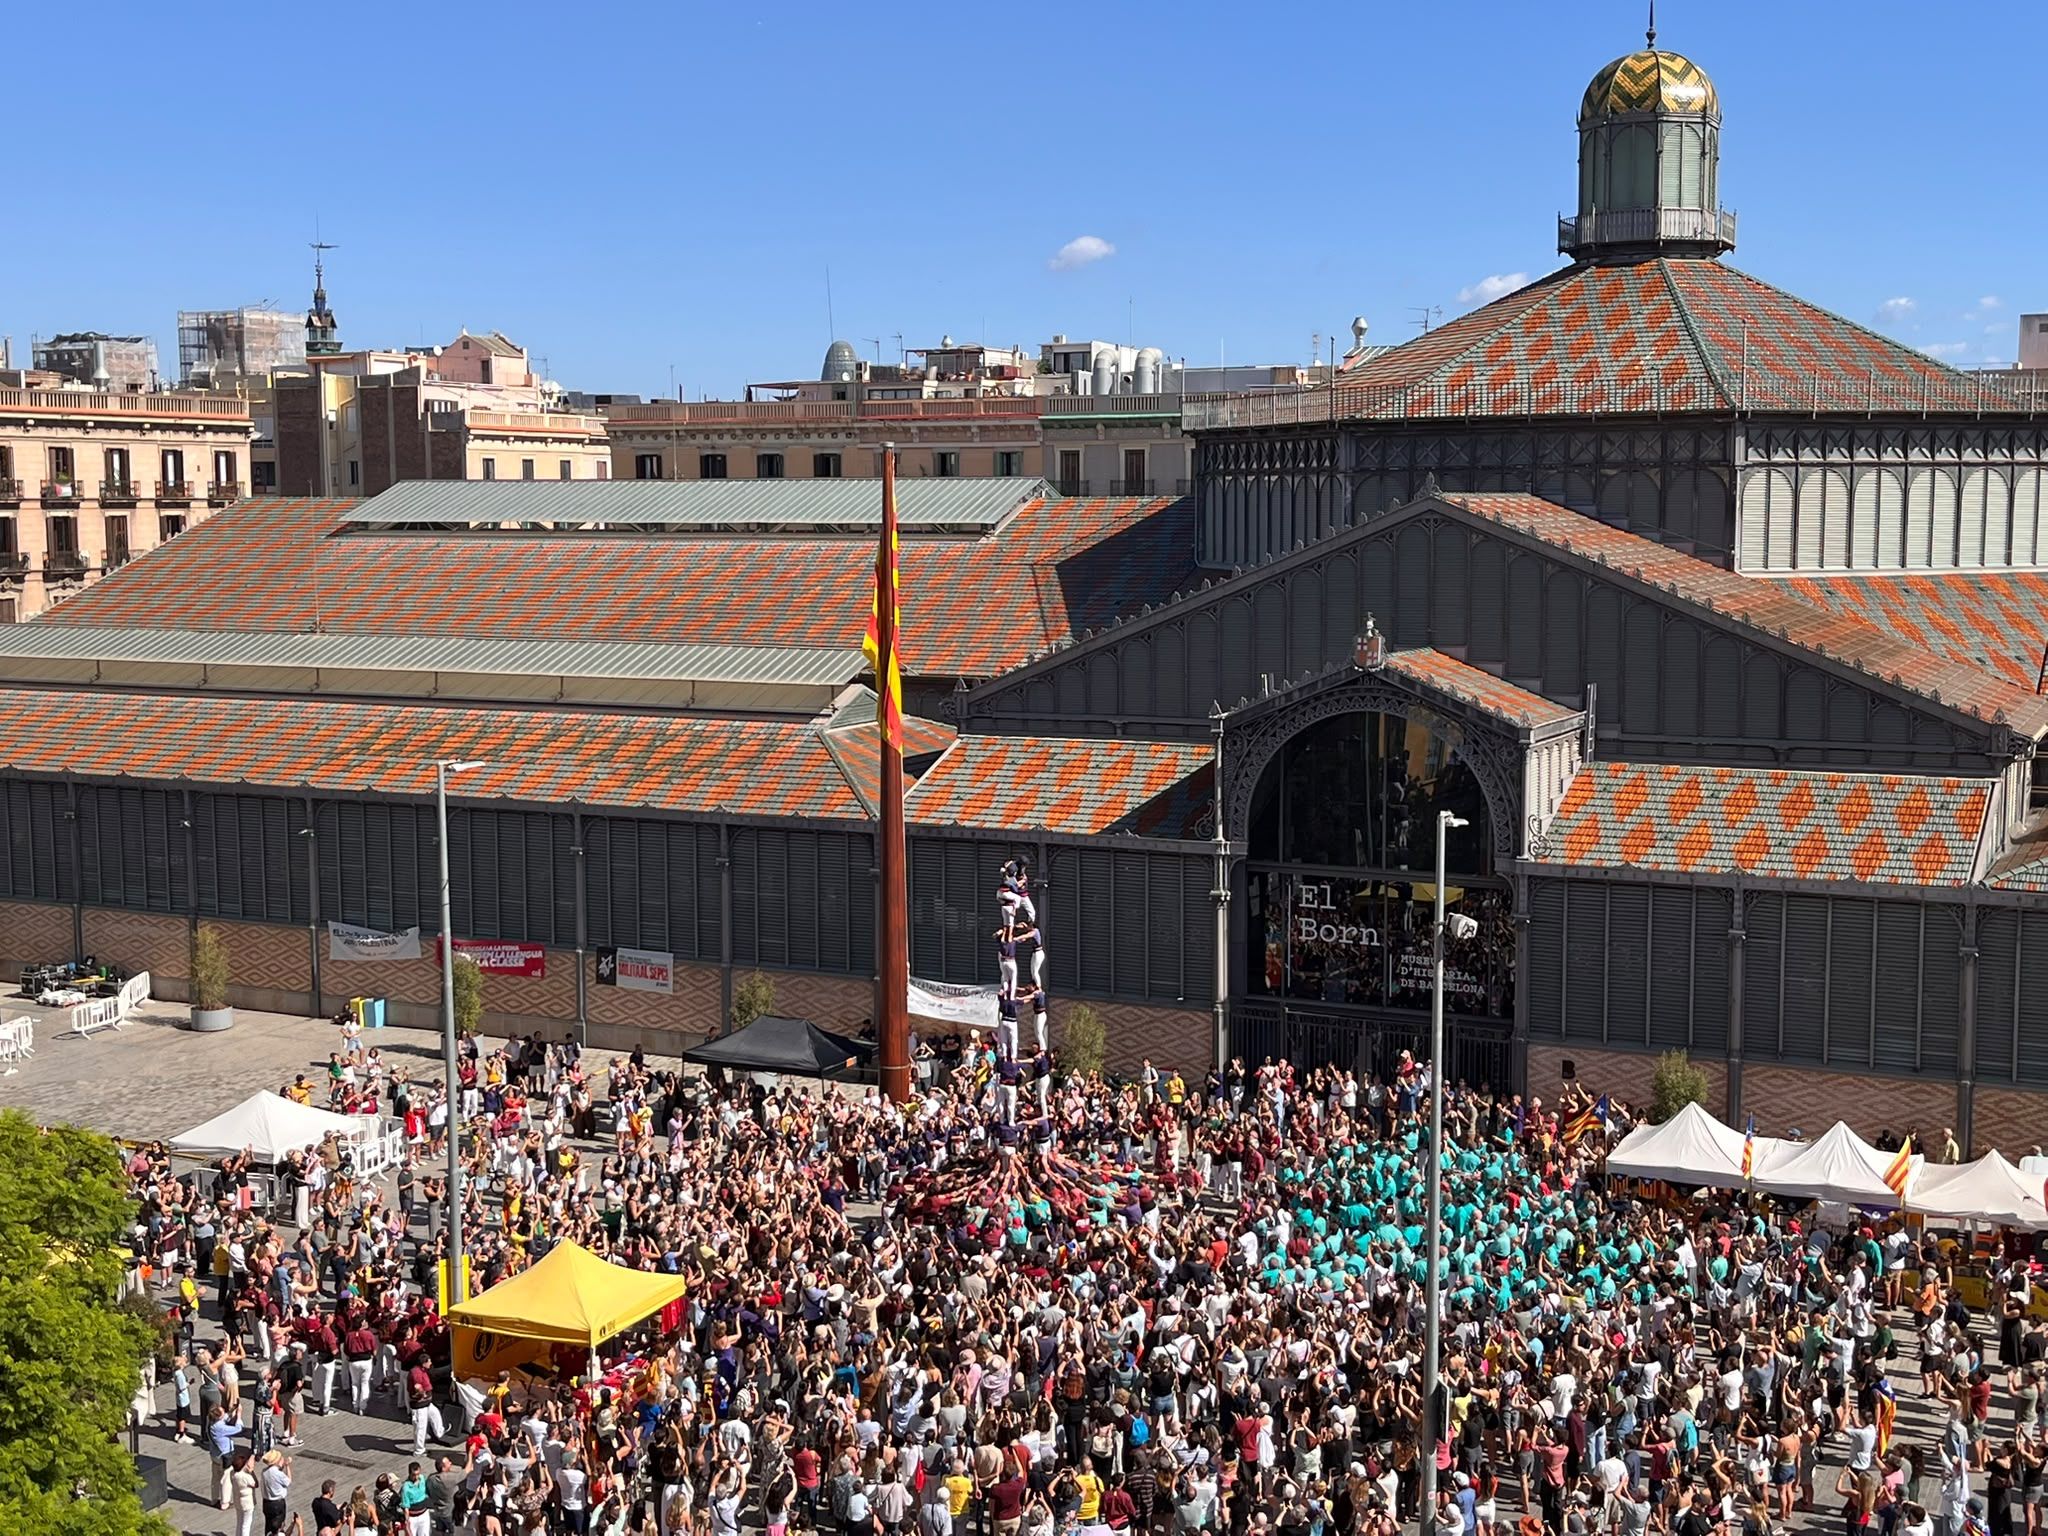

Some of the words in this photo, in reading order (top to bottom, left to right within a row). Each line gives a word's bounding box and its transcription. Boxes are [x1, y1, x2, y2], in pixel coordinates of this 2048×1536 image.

[1299, 885, 1336, 910] El
[1299, 917, 1380, 946] Born
[489, 958, 525, 967] CLASSE
[495, 951, 505, 959] LA
[506, 951, 544, 959] LLENGUA
[1401, 979, 1415, 988] DE
[1418, 980, 1485, 994] BACELONA
